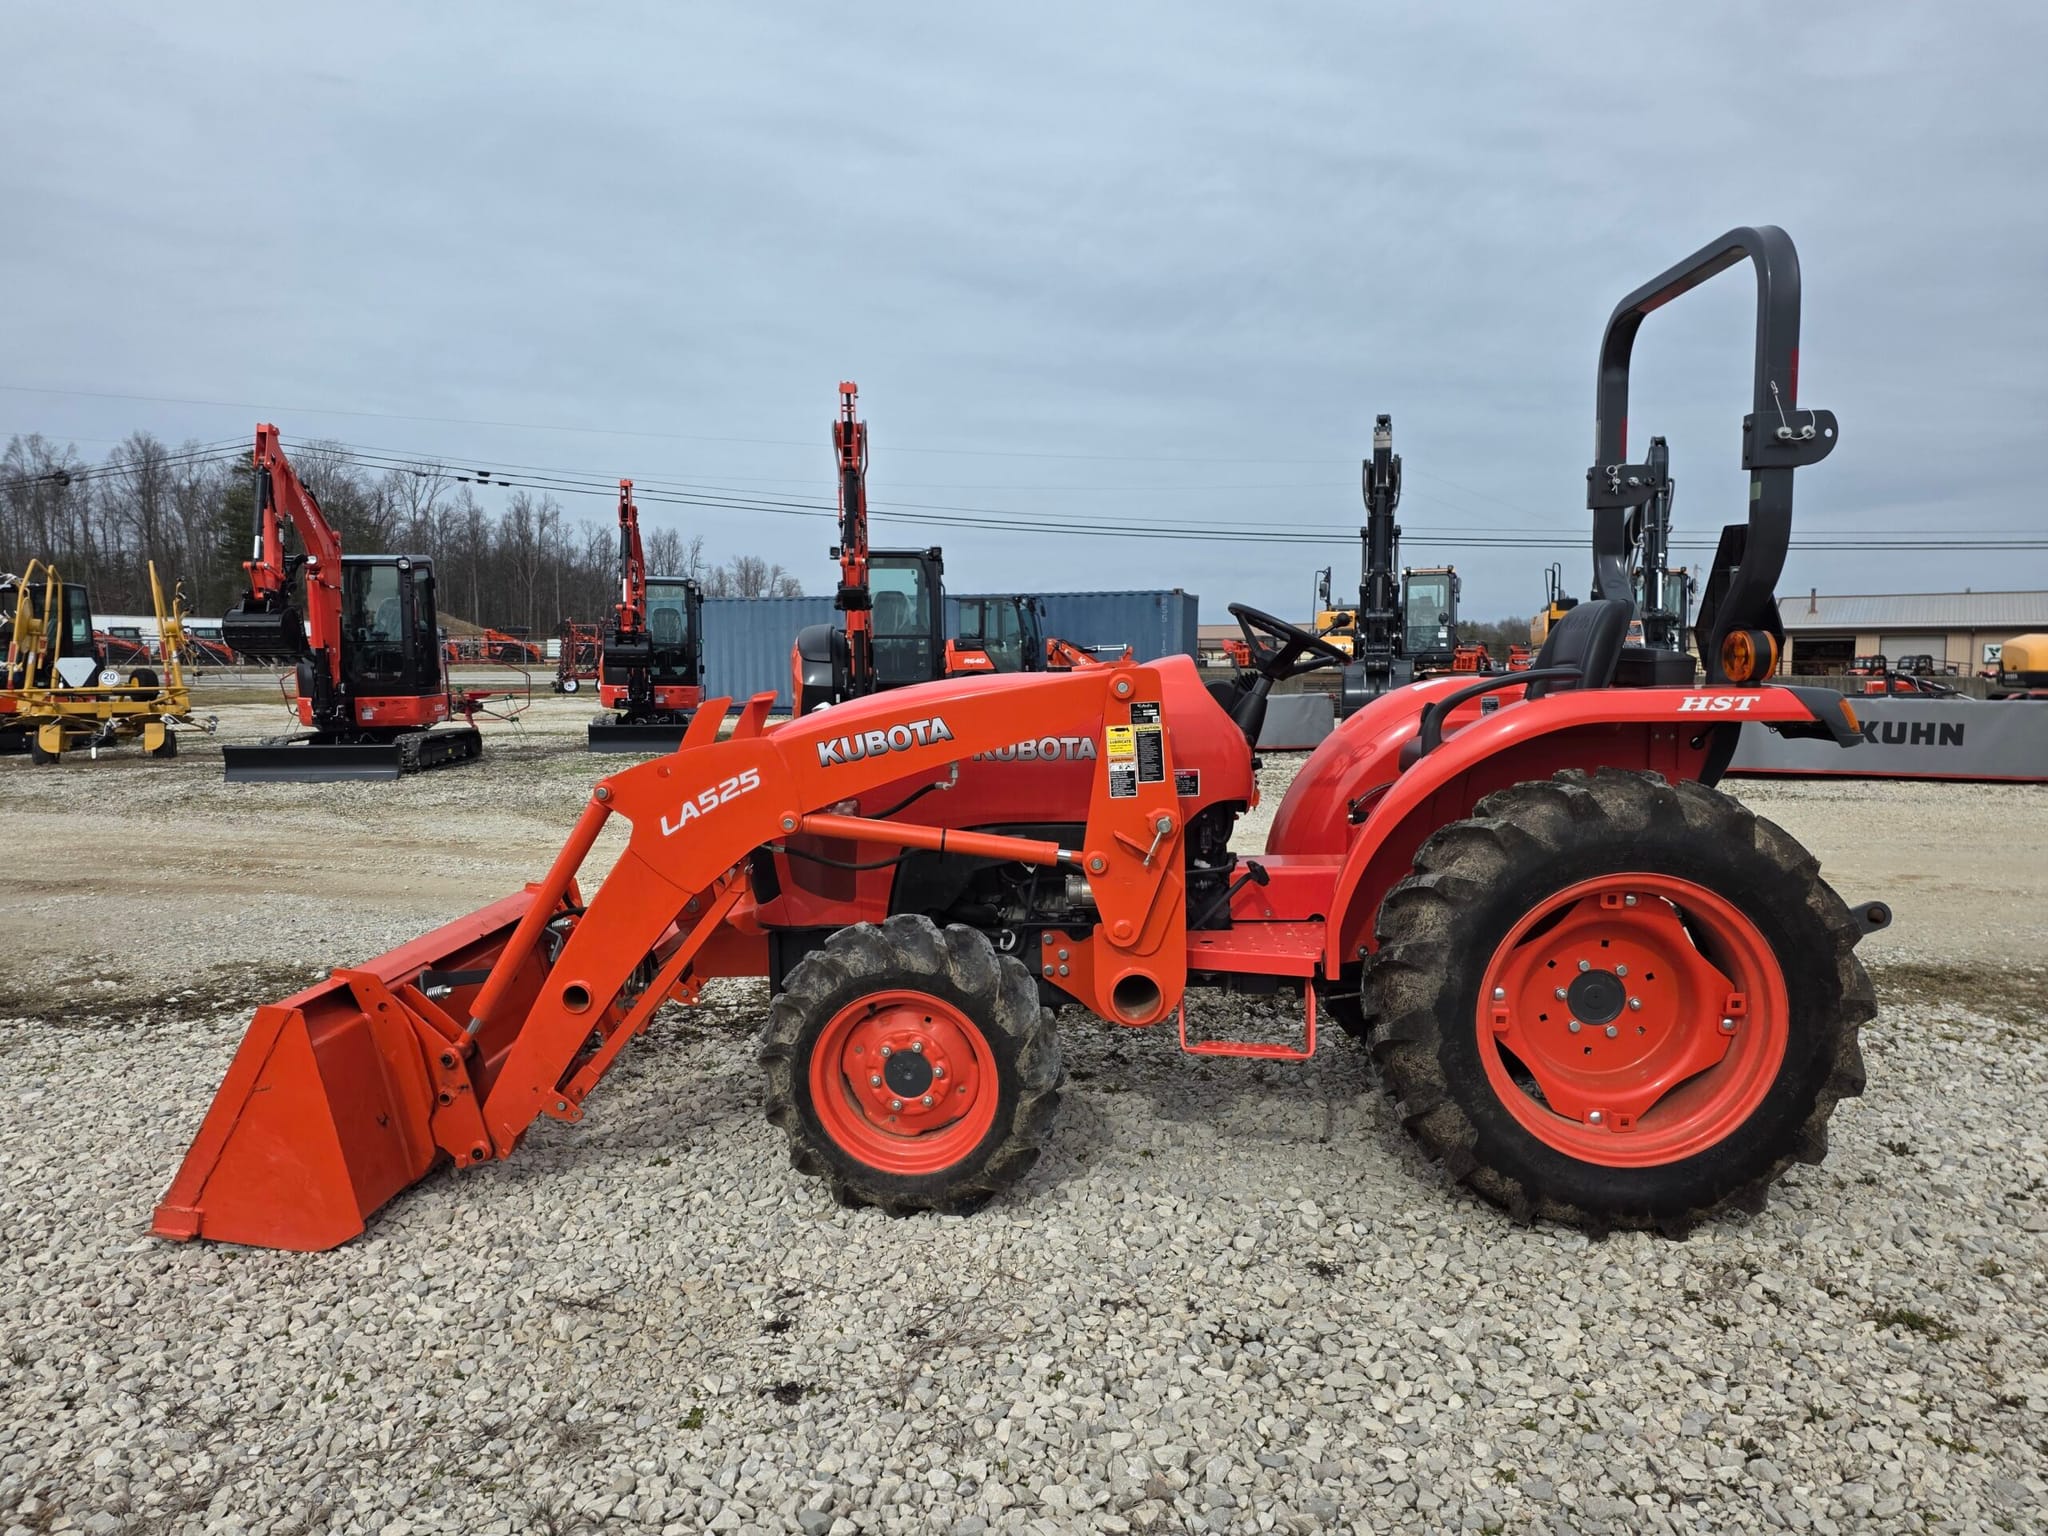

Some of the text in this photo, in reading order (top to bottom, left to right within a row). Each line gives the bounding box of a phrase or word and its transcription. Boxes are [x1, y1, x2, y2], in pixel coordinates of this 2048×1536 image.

[103, 672, 116, 681] 20
[1677, 696, 1760, 712] HST
[816, 716, 954, 767] KUBOTA
[1858, 721, 1965, 746] KUHN
[660, 767, 761, 837] LA525
